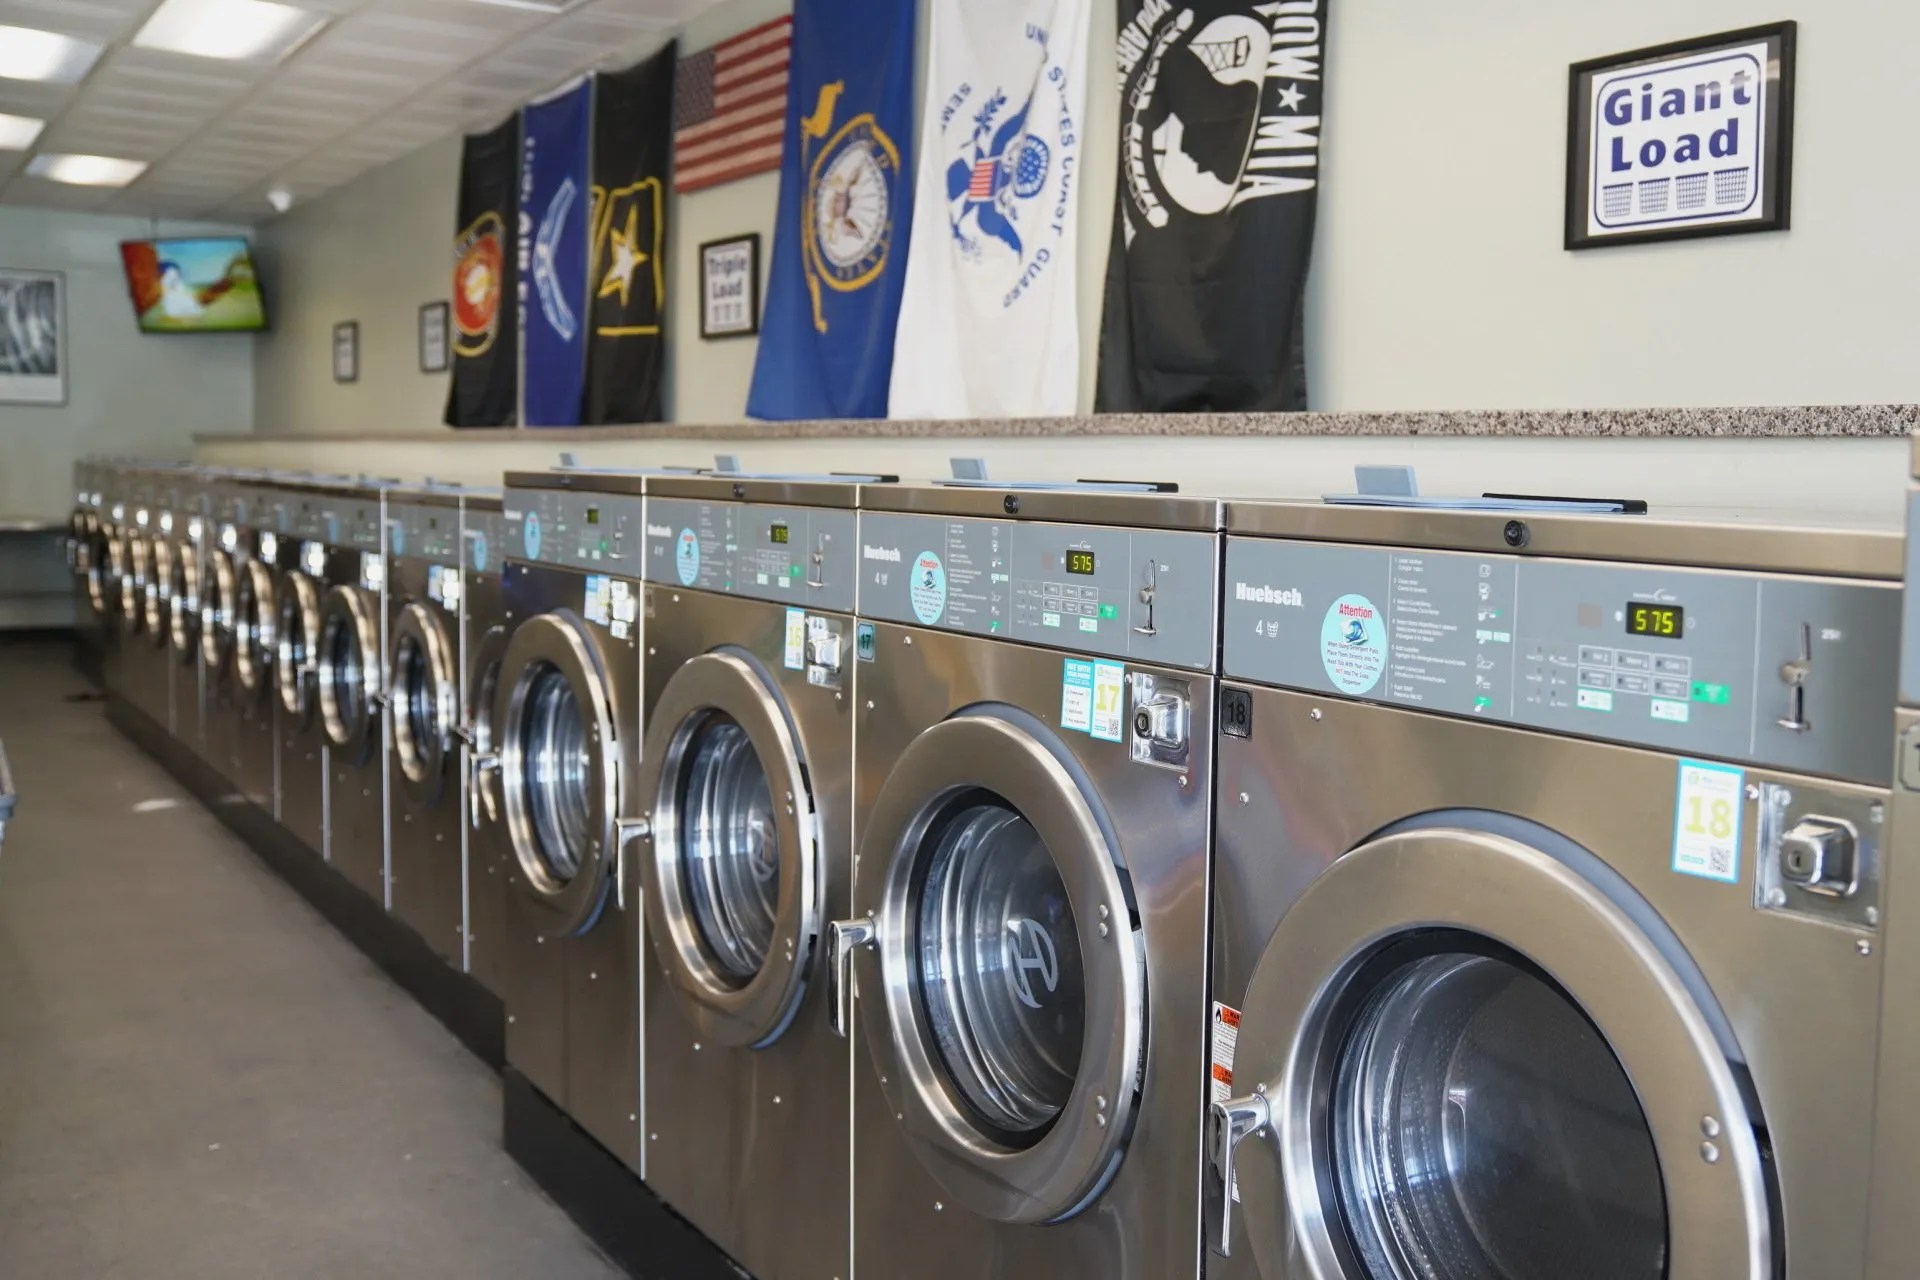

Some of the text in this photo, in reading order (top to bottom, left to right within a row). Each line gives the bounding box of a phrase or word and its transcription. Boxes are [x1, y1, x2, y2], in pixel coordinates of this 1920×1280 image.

[1604, 69, 1752, 127] Giant
[1611, 118, 1739, 173] Load
[1228, 115, 1320, 212] MIA
[707, 253, 747, 278] Triple
[711, 277, 743, 300] Load
[1235, 582, 1303, 607] Huebsch
[1339, 603, 1373, 619] Attention
[1255, 619, 1264, 636] 4
[860, 633, 872, 650] 17
[1095, 684, 1121, 713] 17
[1227, 701, 1246, 725] 18
[1685, 796, 1731, 839] 18
